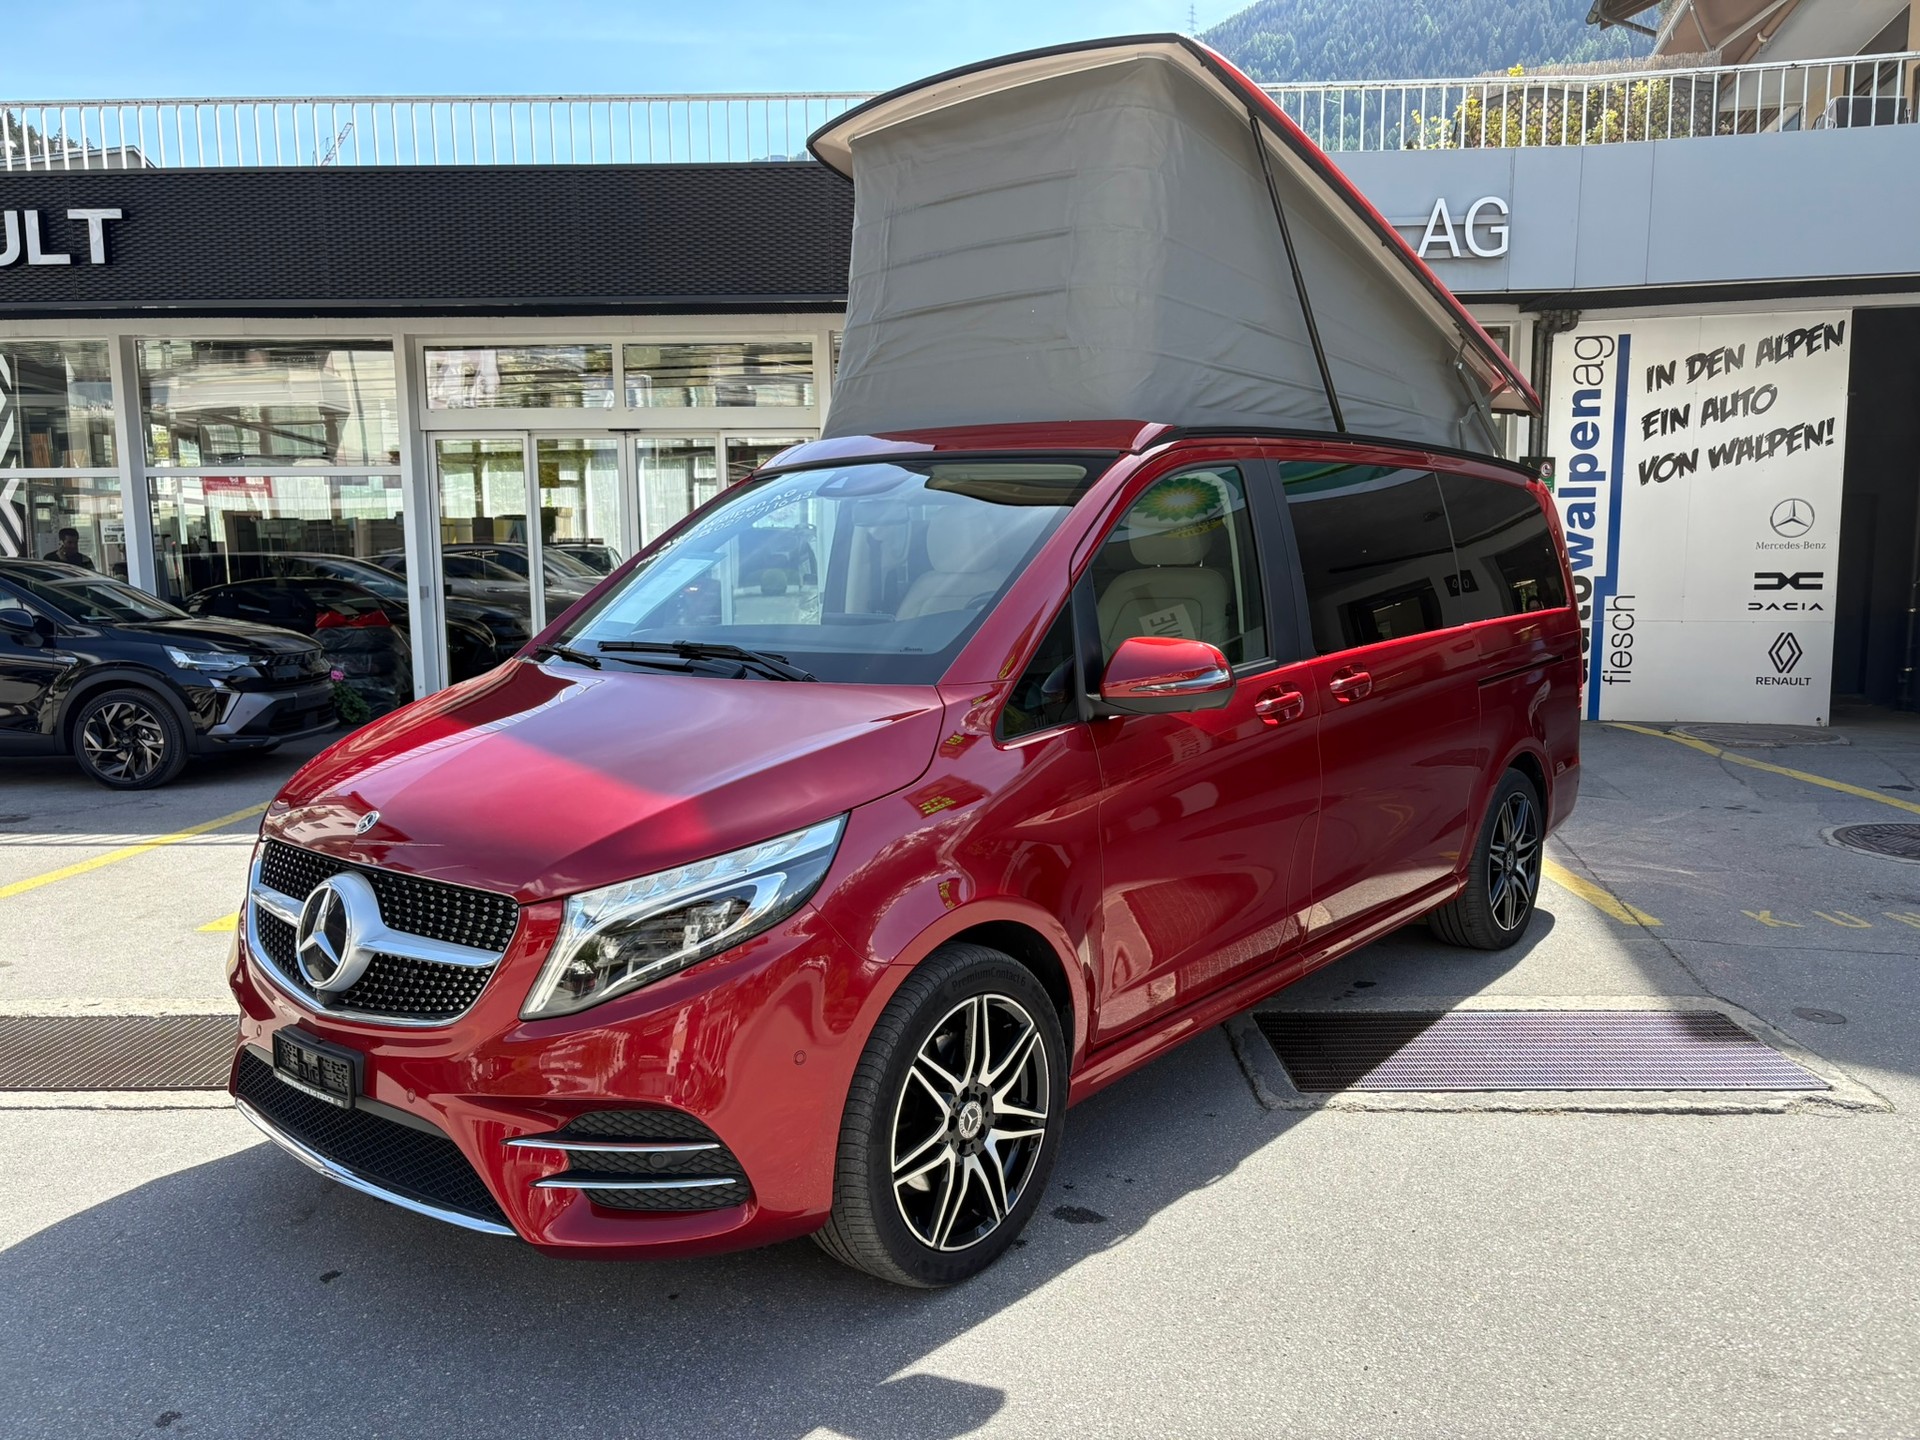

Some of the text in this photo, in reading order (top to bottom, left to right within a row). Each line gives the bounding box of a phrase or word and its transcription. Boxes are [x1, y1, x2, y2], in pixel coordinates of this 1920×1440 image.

[1416, 196, 1510, 258] AG
[1646, 320, 1846, 394] IN DEN ALPEN
[1641, 383, 1778, 441] EIN AUTO
[1638, 416, 1835, 486] VON WALPEN!
[1558, 335, 1615, 685] owalpenag
[1755, 541, 1827, 550] Mercedes-Benz
[1747, 602, 1824, 611] DACIA
[1602, 595, 1636, 685] fiesch
[1755, 676, 1812, 687] RENAULT
